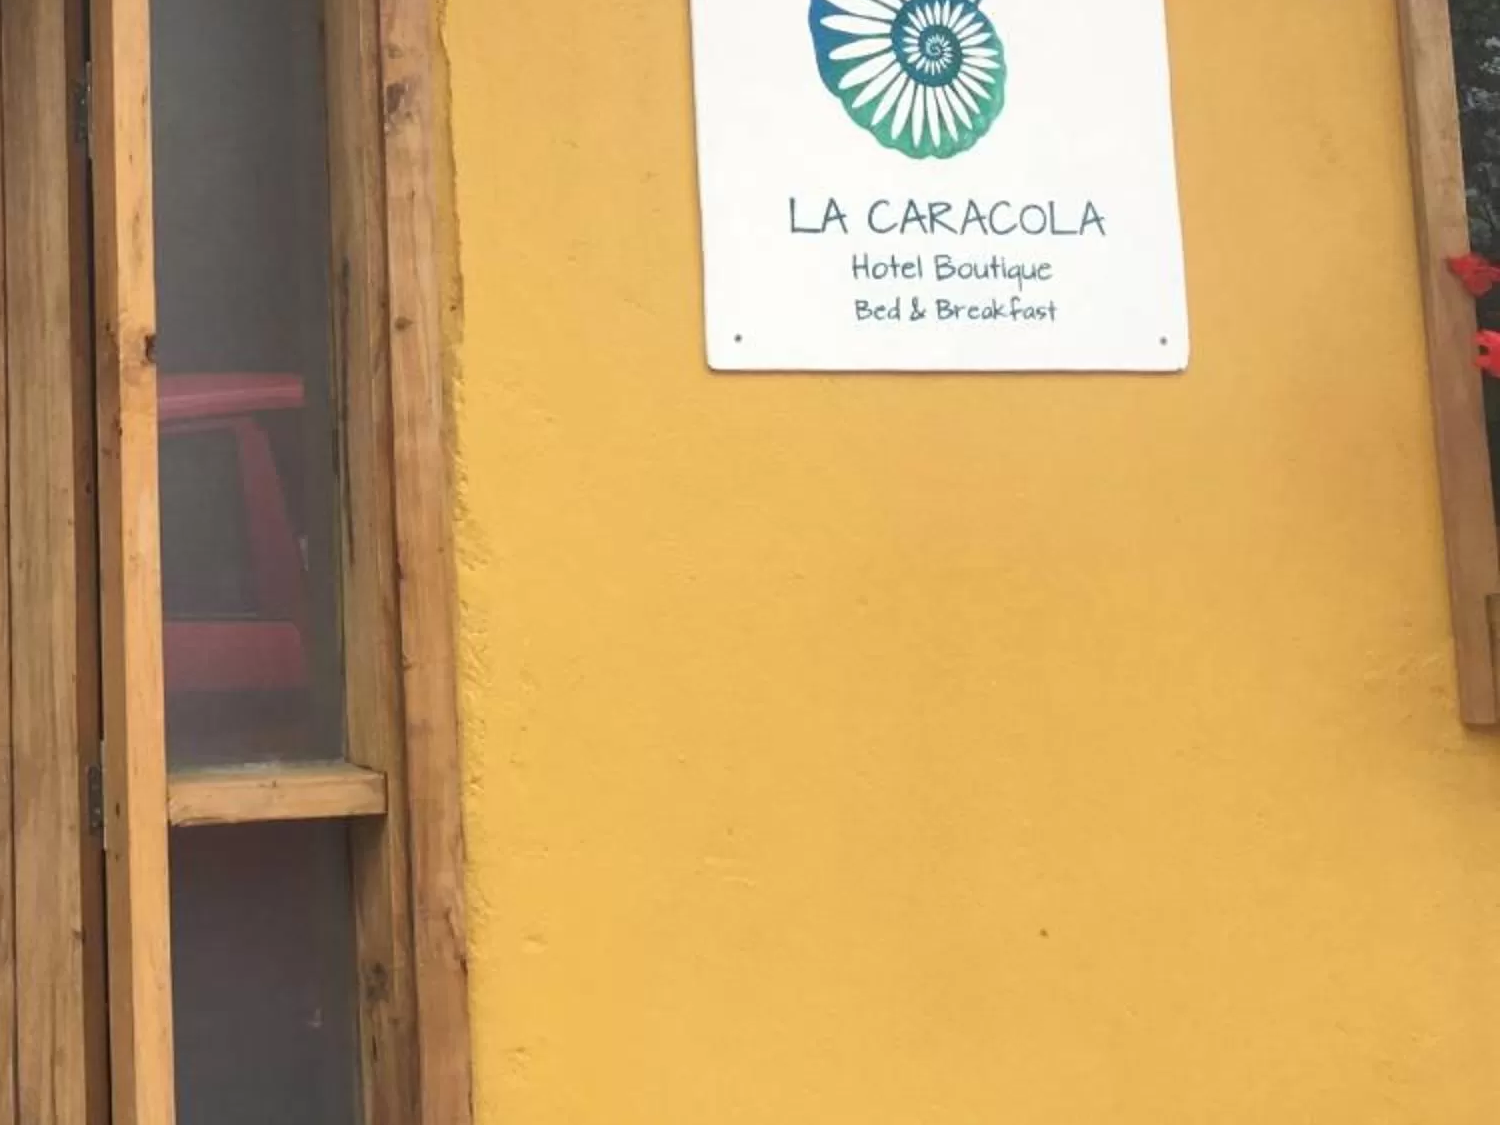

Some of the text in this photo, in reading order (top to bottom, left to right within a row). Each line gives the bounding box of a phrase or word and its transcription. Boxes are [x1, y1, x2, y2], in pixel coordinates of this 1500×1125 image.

[789, 197, 1106, 236] LA CARACOLA
[851, 253, 1053, 291] Hotel Boutique
[854, 296, 1057, 321] Bed & Breakfast
